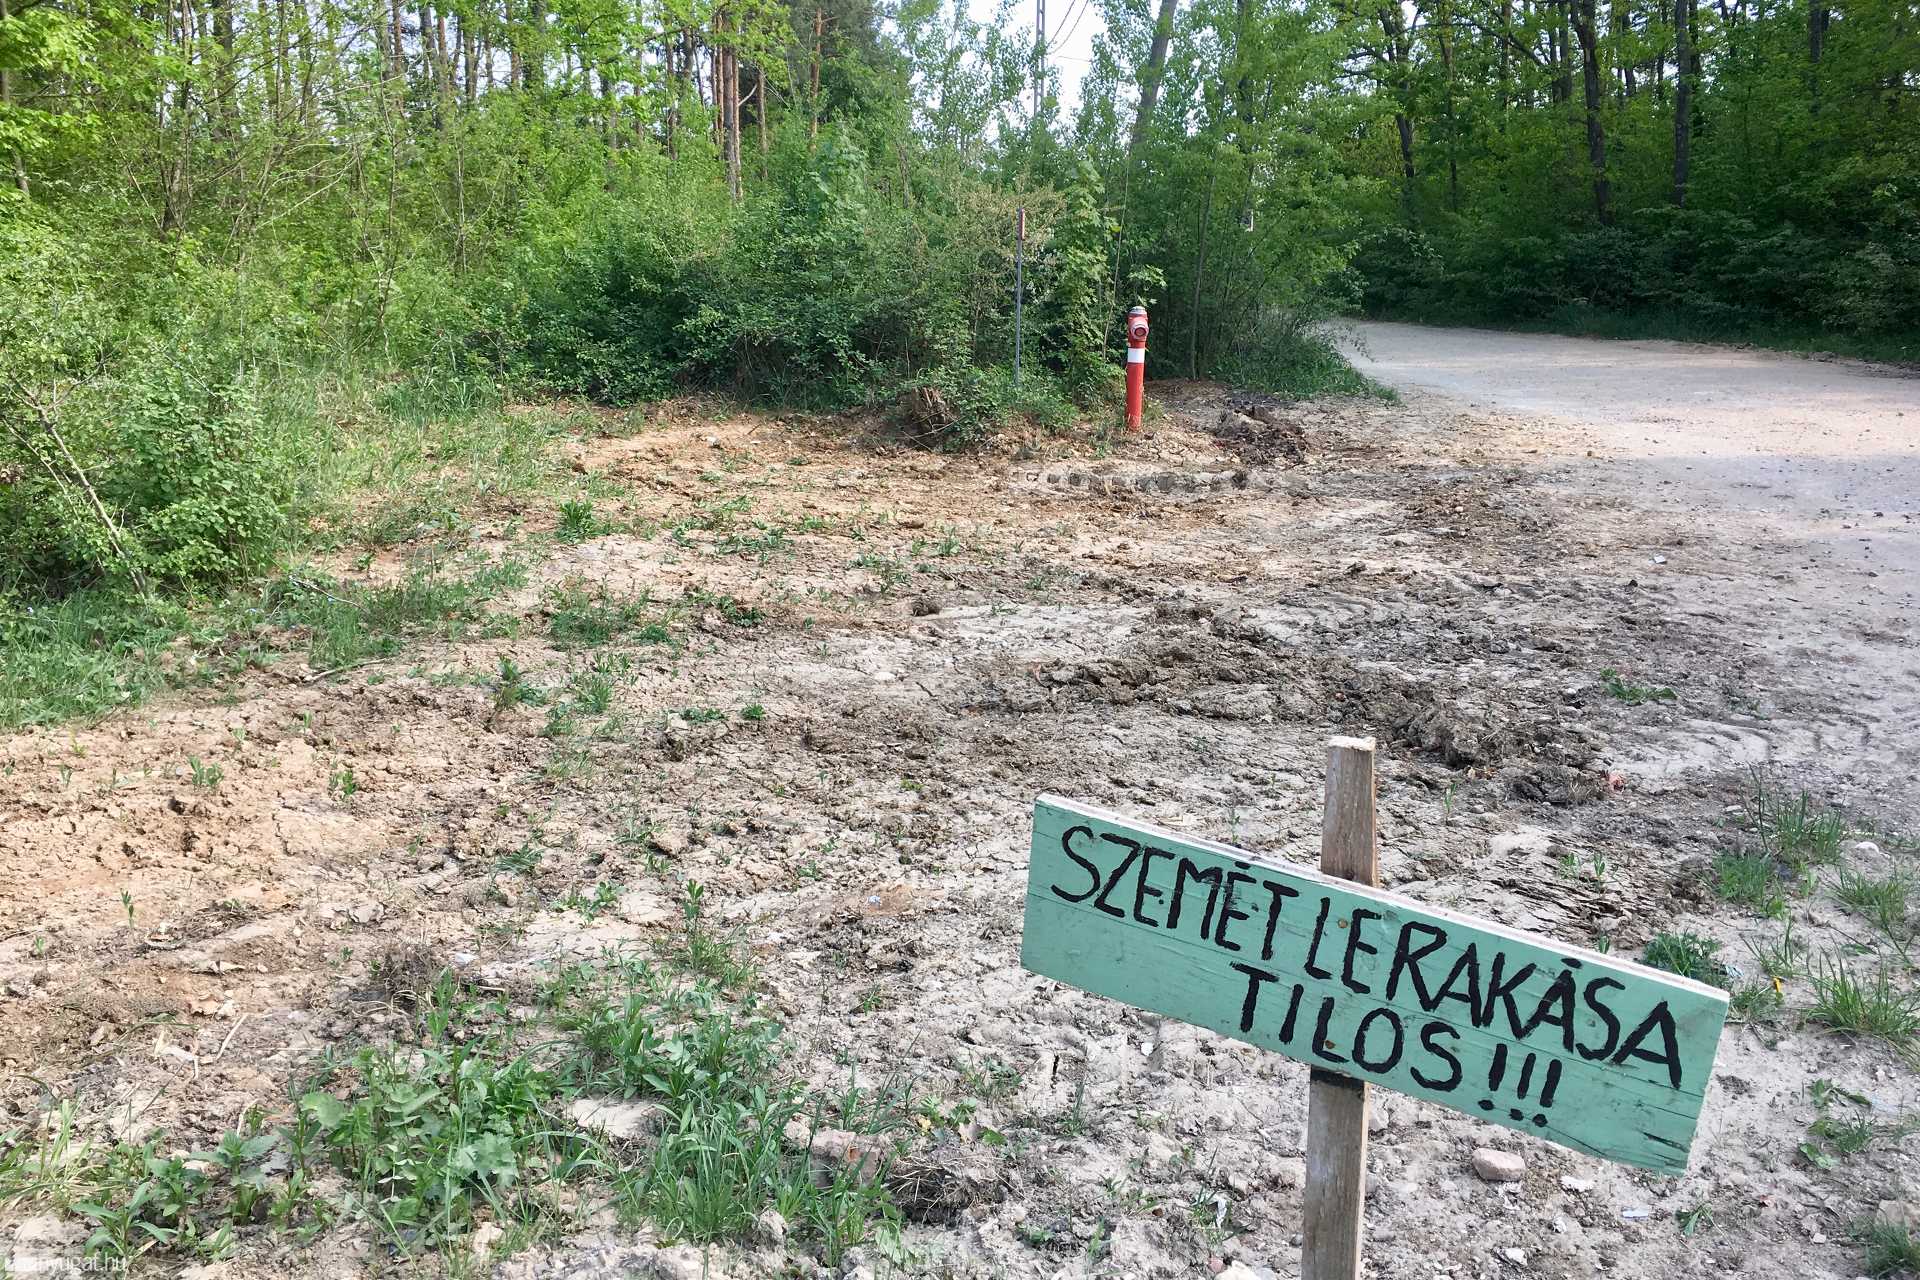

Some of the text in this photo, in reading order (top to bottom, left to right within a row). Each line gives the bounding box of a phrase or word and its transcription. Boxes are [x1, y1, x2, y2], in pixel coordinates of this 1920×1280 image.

[1051, 825, 1683, 1089] SZEMÉT LERAKÁSA
[1230, 961, 1562, 1127] TILOS!!!
